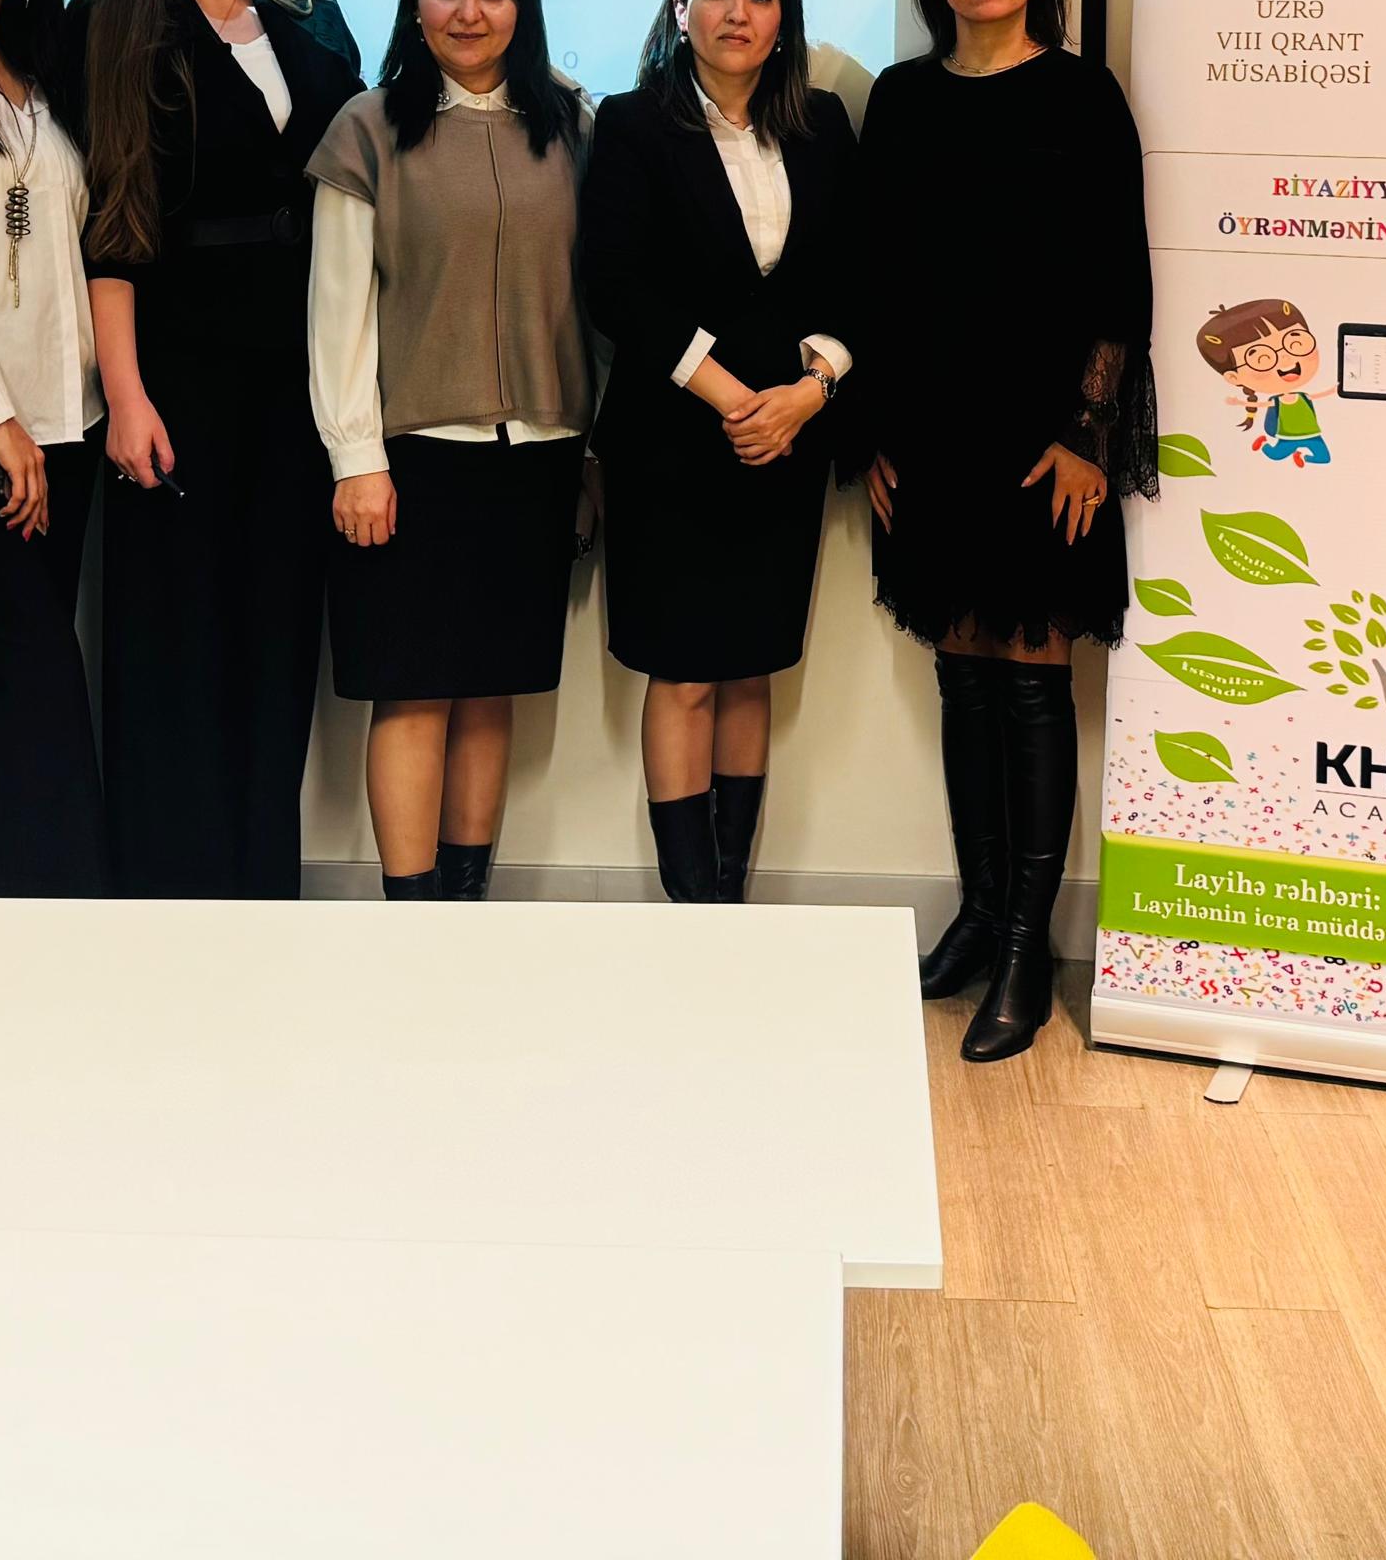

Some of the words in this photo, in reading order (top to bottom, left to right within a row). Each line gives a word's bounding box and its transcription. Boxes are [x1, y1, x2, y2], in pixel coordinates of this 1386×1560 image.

[1216, 31, 1262, 51] VIII
[1271, 32, 1364, 56] QRANT
[1206, 59, 1371, 88] MÜSABİQƏSİ
[1174, 863, 1266, 897] Layihə
[1274, 879, 1381, 911] rəhbəri:
[1133, 892, 1247, 925] Layihənin
[1255, 907, 1300, 933] icra
